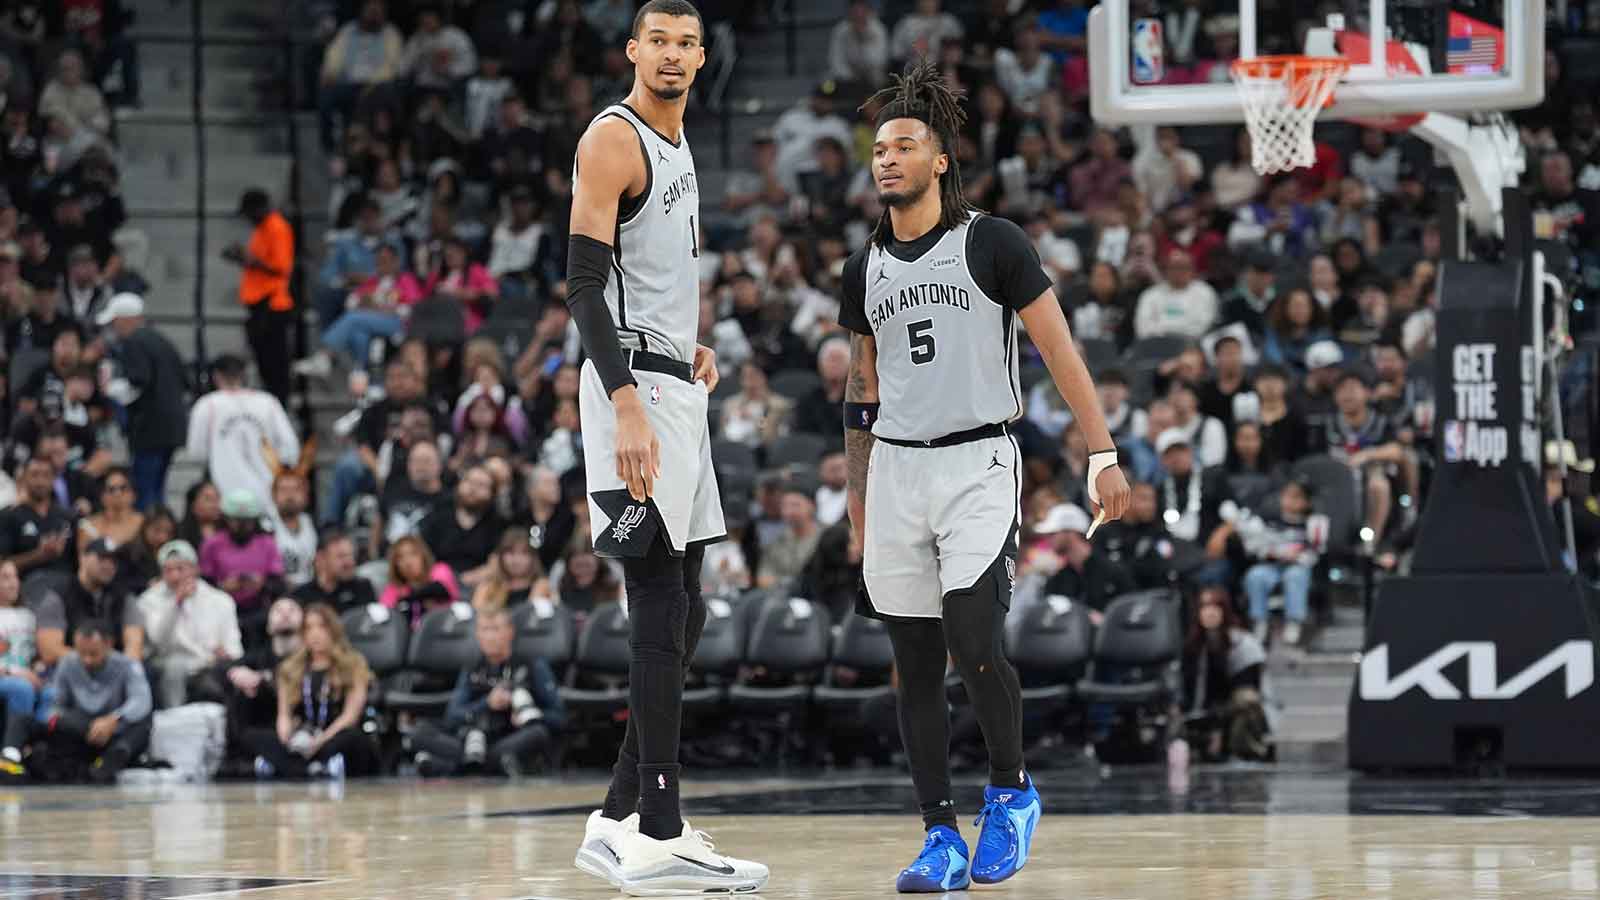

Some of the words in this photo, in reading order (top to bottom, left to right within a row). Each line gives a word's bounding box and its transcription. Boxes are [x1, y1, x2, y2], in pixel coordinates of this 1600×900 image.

[663, 179, 681, 215] SAN
[871, 296, 896, 332] SAN
[899, 283, 970, 312] ANTONIO
[906, 318, 936, 366] 5
[1453, 343, 1497, 382] GET
[1453, 383, 1497, 420] THE
[1464, 420, 1508, 468] App
[1360, 639, 1595, 701] KIA
